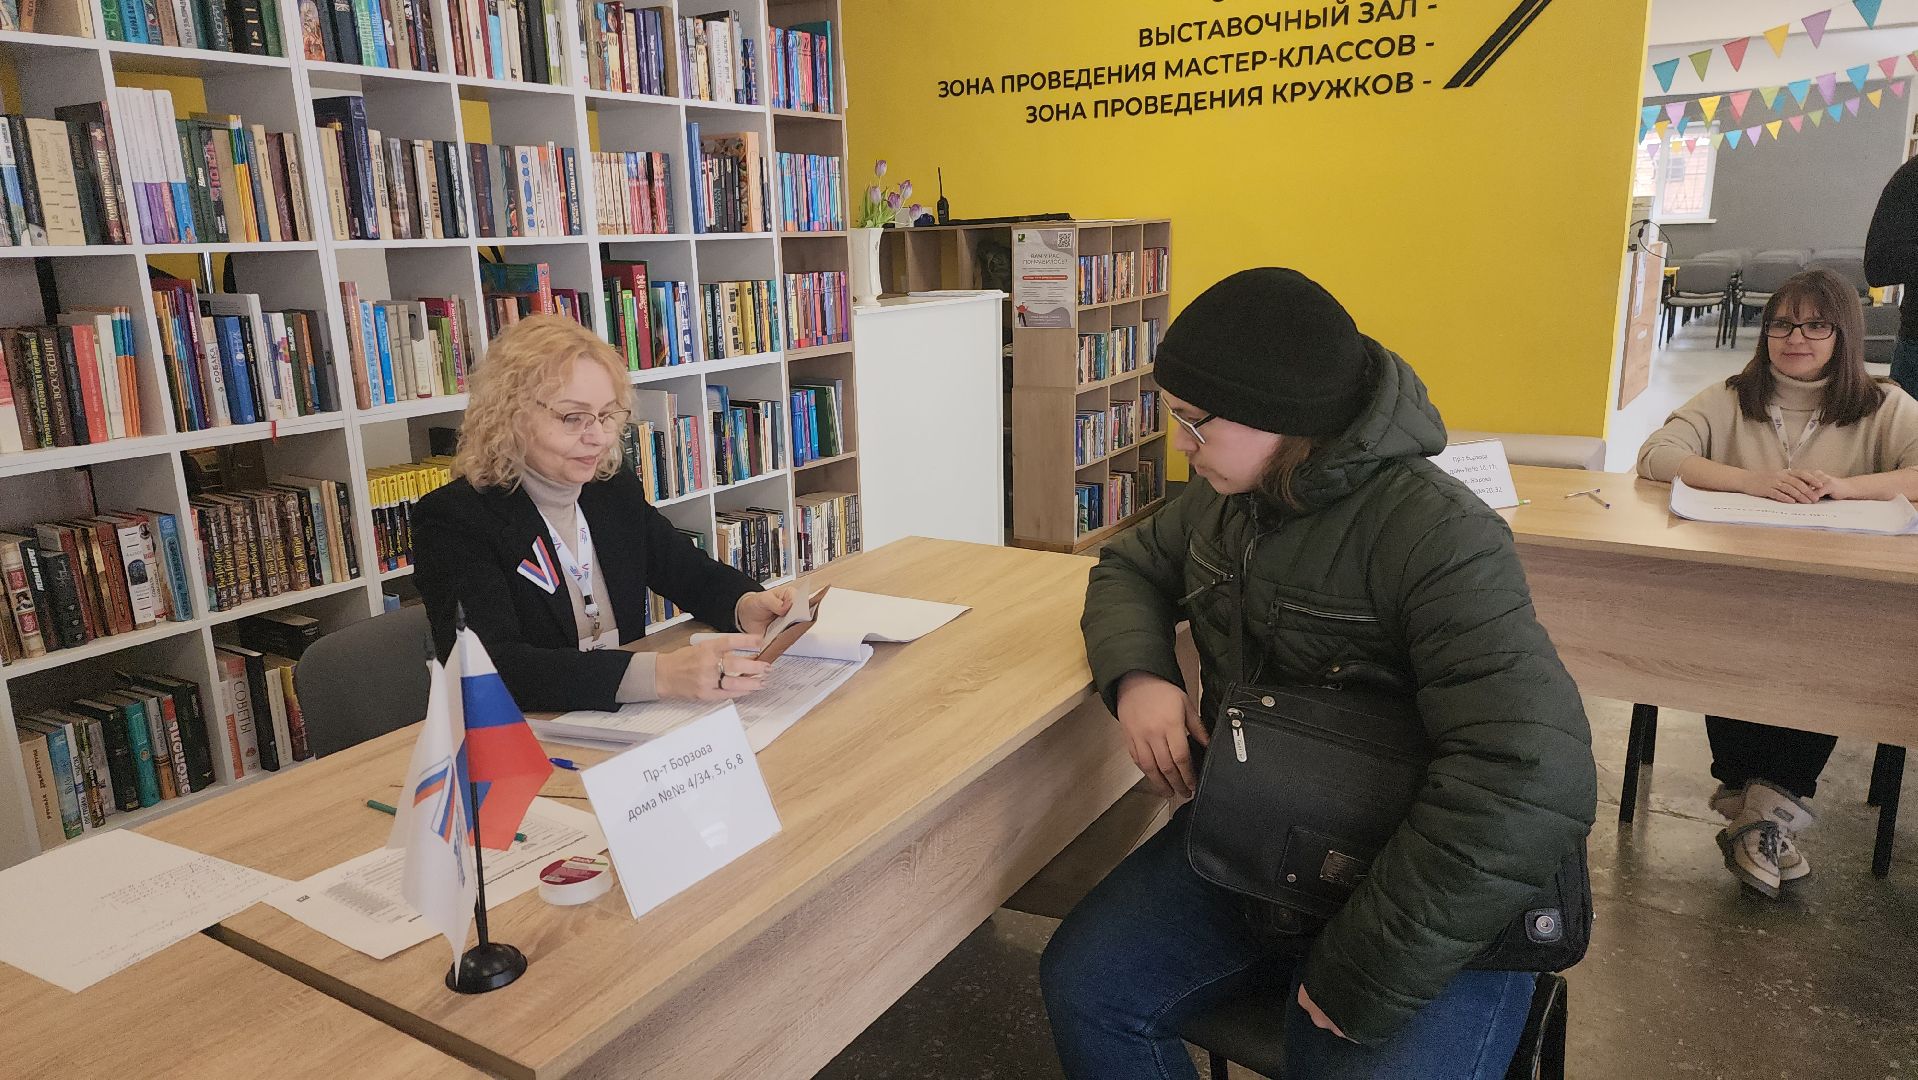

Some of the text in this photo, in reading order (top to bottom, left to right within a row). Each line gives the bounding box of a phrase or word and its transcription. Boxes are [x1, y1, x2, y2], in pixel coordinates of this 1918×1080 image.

[1139, 0, 1350, 48] ВЫСТАВОЧНЫЙ
[1357, 0, 1417, 24] ЗАЛ
[937, 76, 995, 99] ЗОНА
[1001, 61, 1156, 94] ПРОВЕДЕНИЯ
[1164, 34, 1416, 80] МАСТЕР-КЛАССОВ
[1025, 101, 1088, 124] ЗОНА
[1093, 86, 1263, 119] ПРОВЕДЕНИЯ
[1272, 71, 1414, 105] КРУЖКОВ
[44, 337, 62, 399] ВОСКРЕСЕНИЕ
[208, 347, 221, 383] СОБАКА
[233, 680, 252, 735] СОВЕТЫ
[627, 797, 658, 823] дома
[726, 757, 738, 772] 6,
[736, 752, 745, 765] 8
[642, 743, 714, 784] Пр-т Борзова
